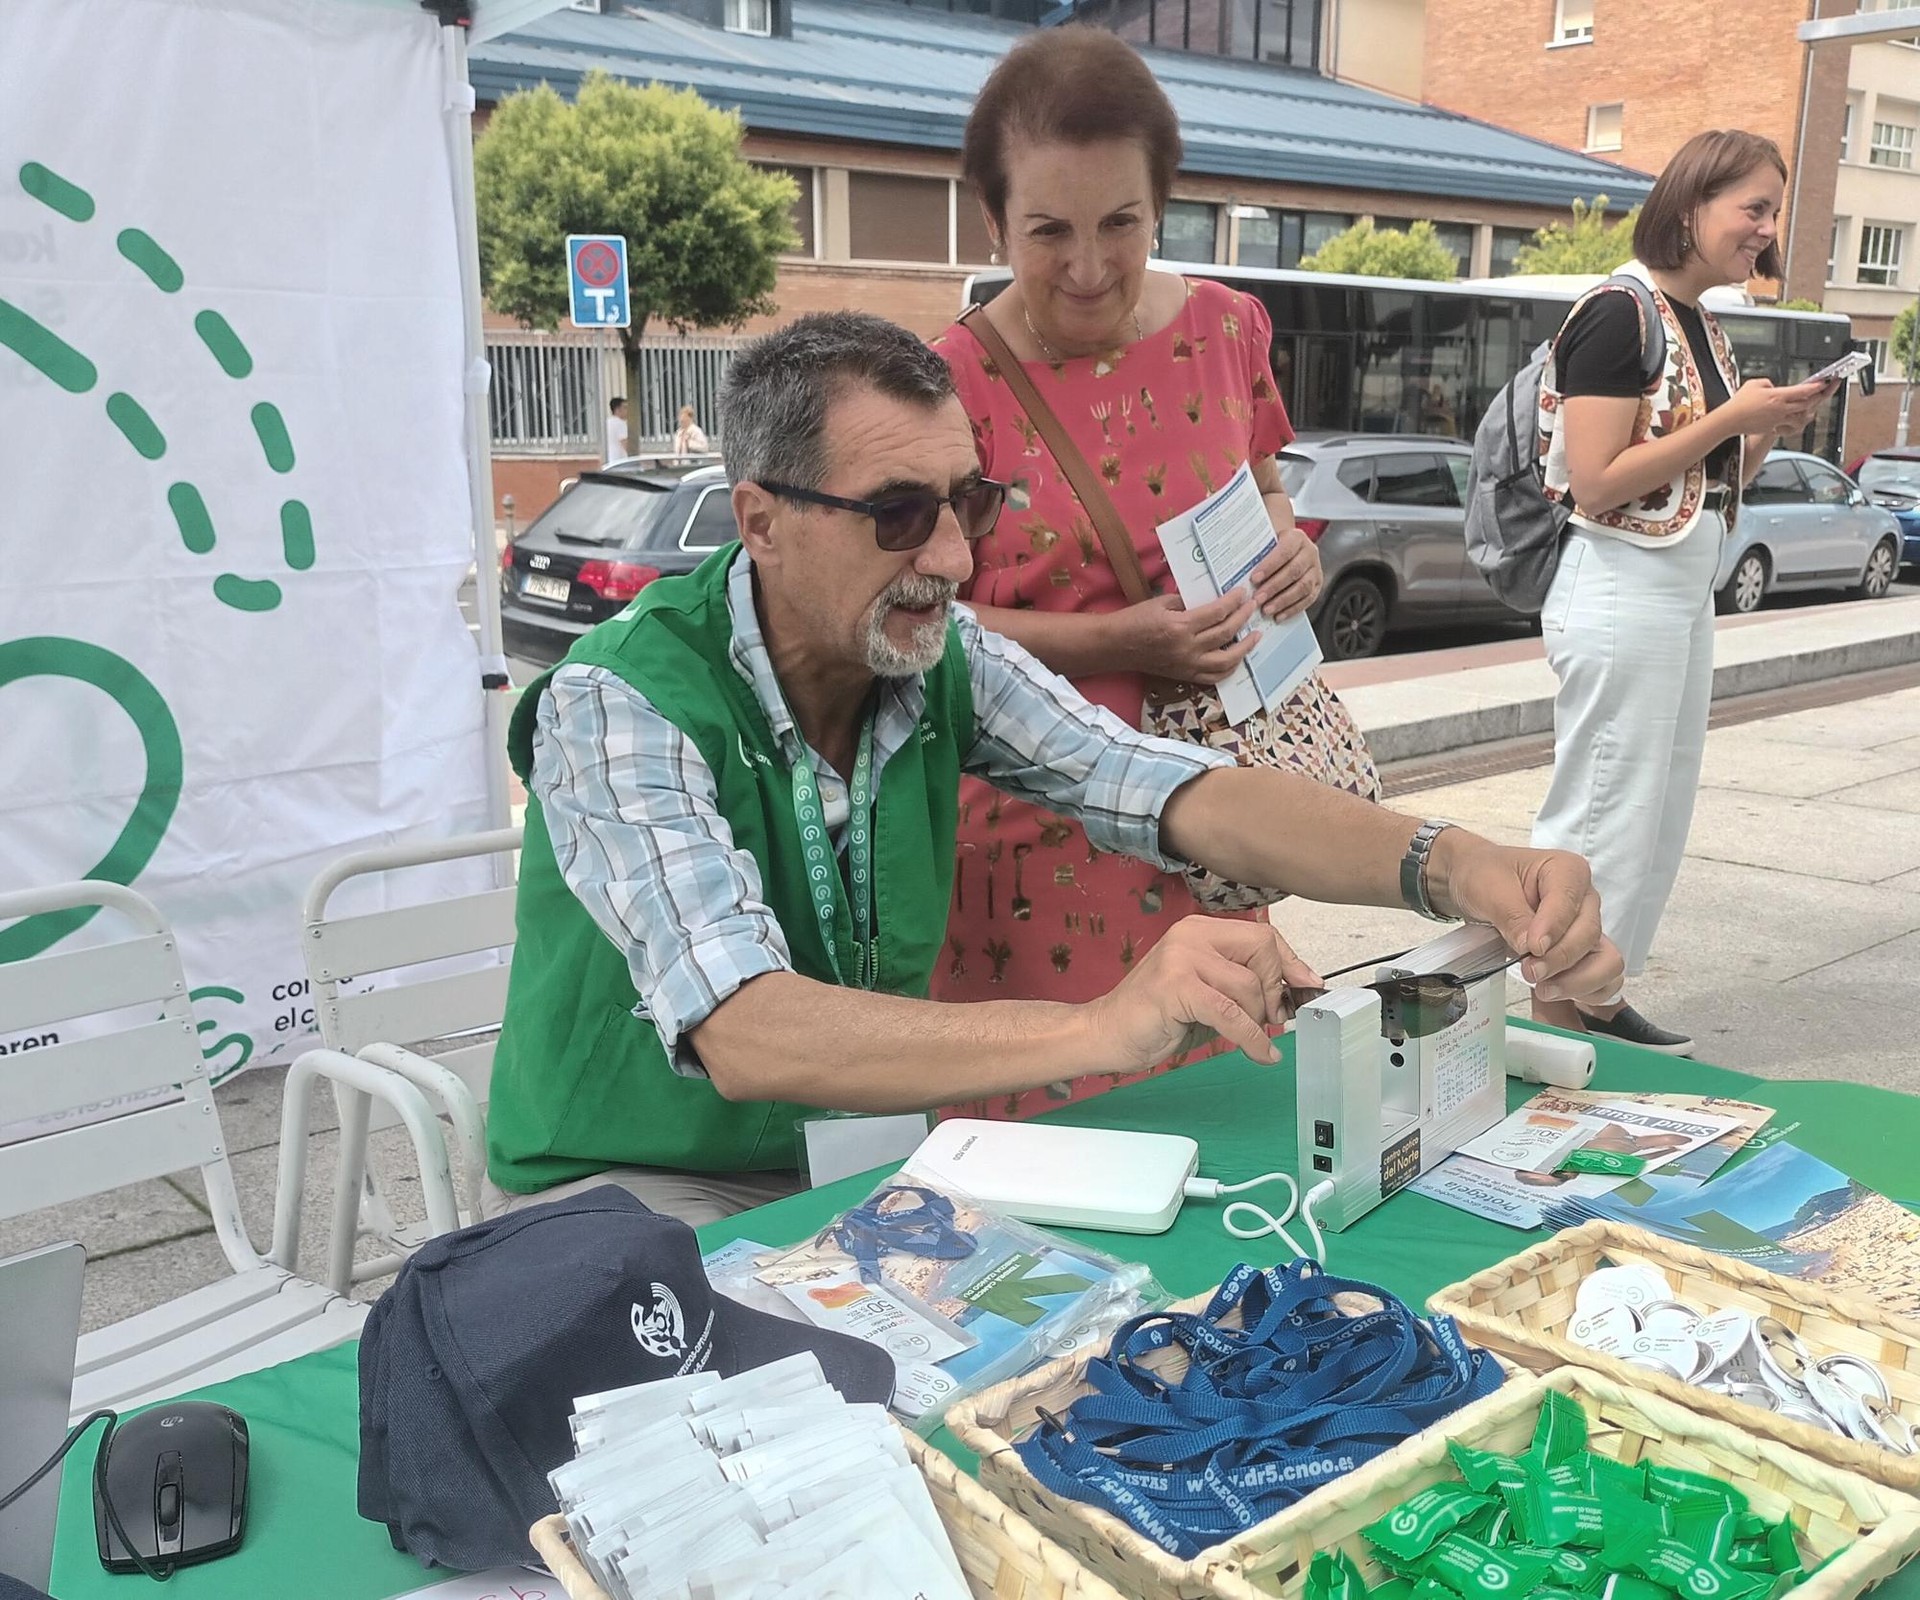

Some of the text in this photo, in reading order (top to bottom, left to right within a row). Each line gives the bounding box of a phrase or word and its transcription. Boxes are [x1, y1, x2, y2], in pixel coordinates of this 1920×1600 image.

[275, 1007, 295, 1031] el
[1591, 1106, 1718, 1138] Salud Visual
[1383, 1161, 1396, 1180] del
[1397, 1150, 1419, 1172] Norte
[1444, 1181, 1522, 1211] Protégela
